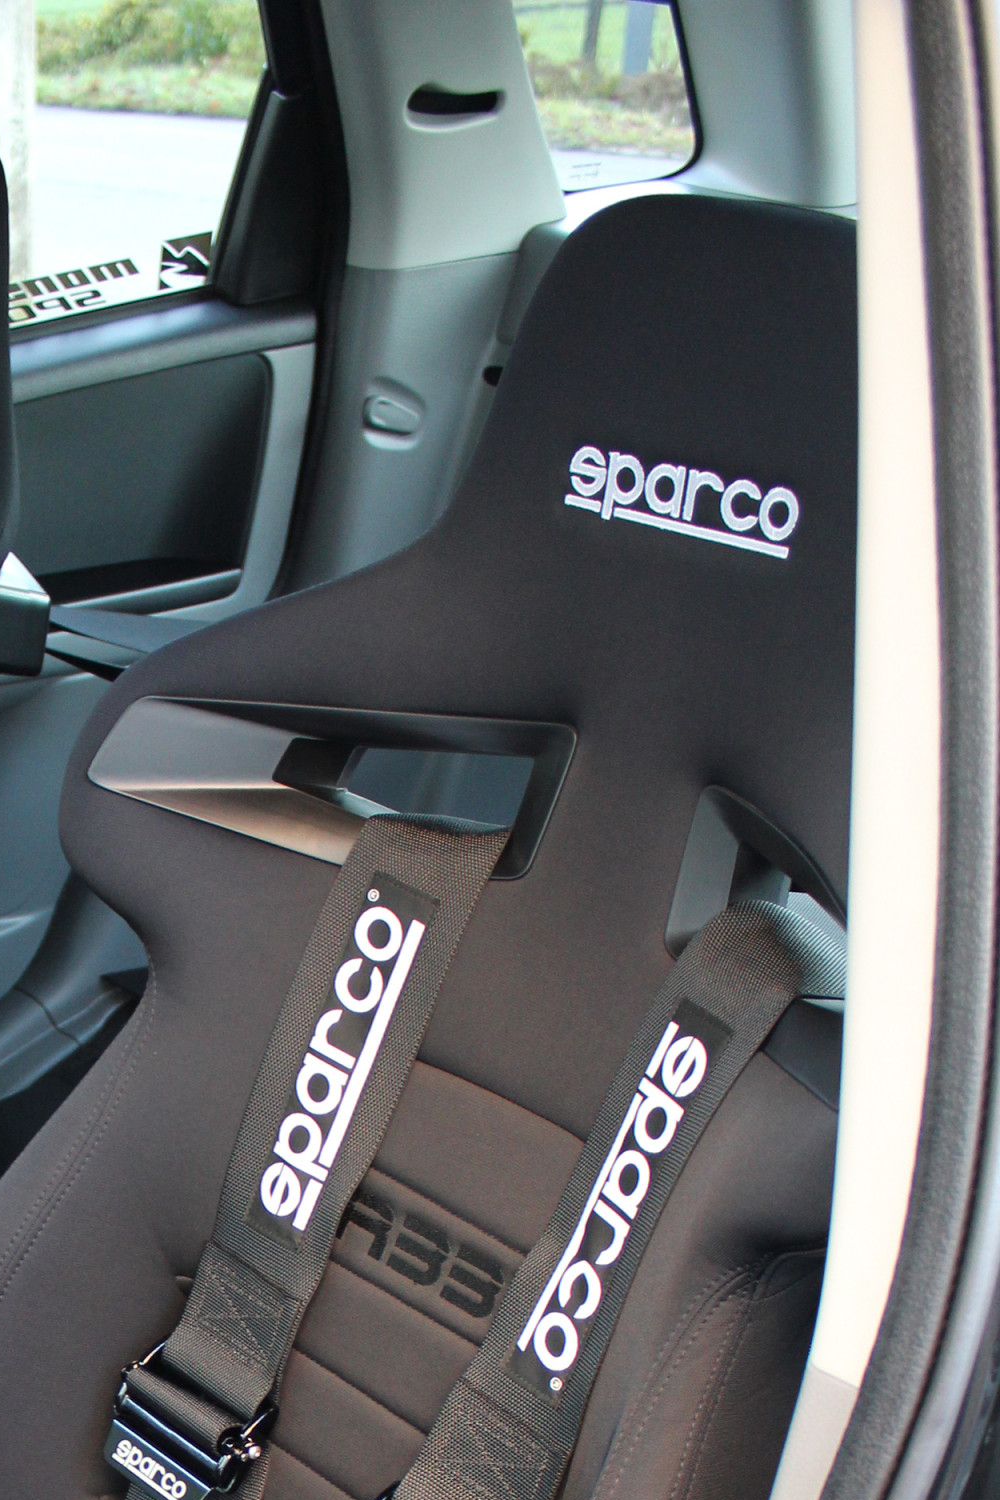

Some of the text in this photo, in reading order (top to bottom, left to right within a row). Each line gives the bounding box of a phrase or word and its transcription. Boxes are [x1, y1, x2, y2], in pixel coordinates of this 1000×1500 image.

[564, 445, 799, 559] sparco
[260, 907, 426, 1232] sparco
[517, 1021, 708, 1371] sparco
